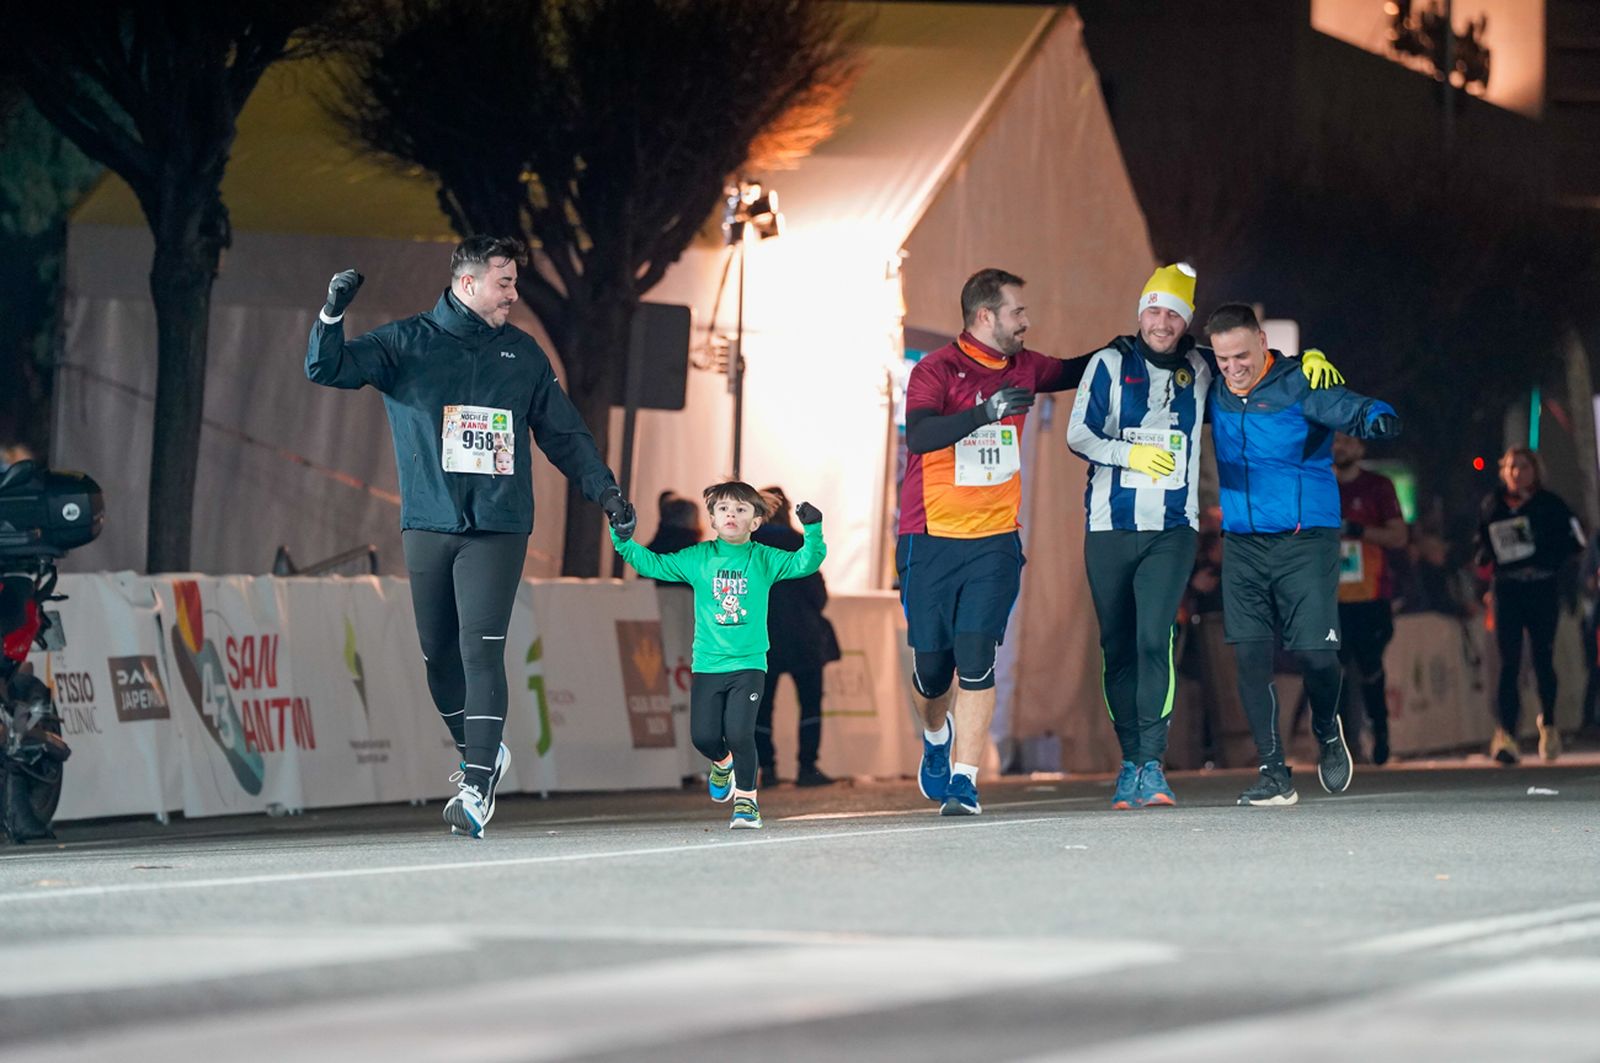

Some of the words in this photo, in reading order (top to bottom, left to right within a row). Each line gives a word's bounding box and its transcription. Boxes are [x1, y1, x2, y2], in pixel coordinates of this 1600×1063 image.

[500, 351, 516, 359] FILA
[462, 430, 493, 451] 958
[978, 447, 1000, 465] 111
[712, 577, 748, 595] FIRE
[226, 634, 279, 690] SAN
[55, 671, 95, 704] FISIO
[62, 707, 103, 734] CLINIC
